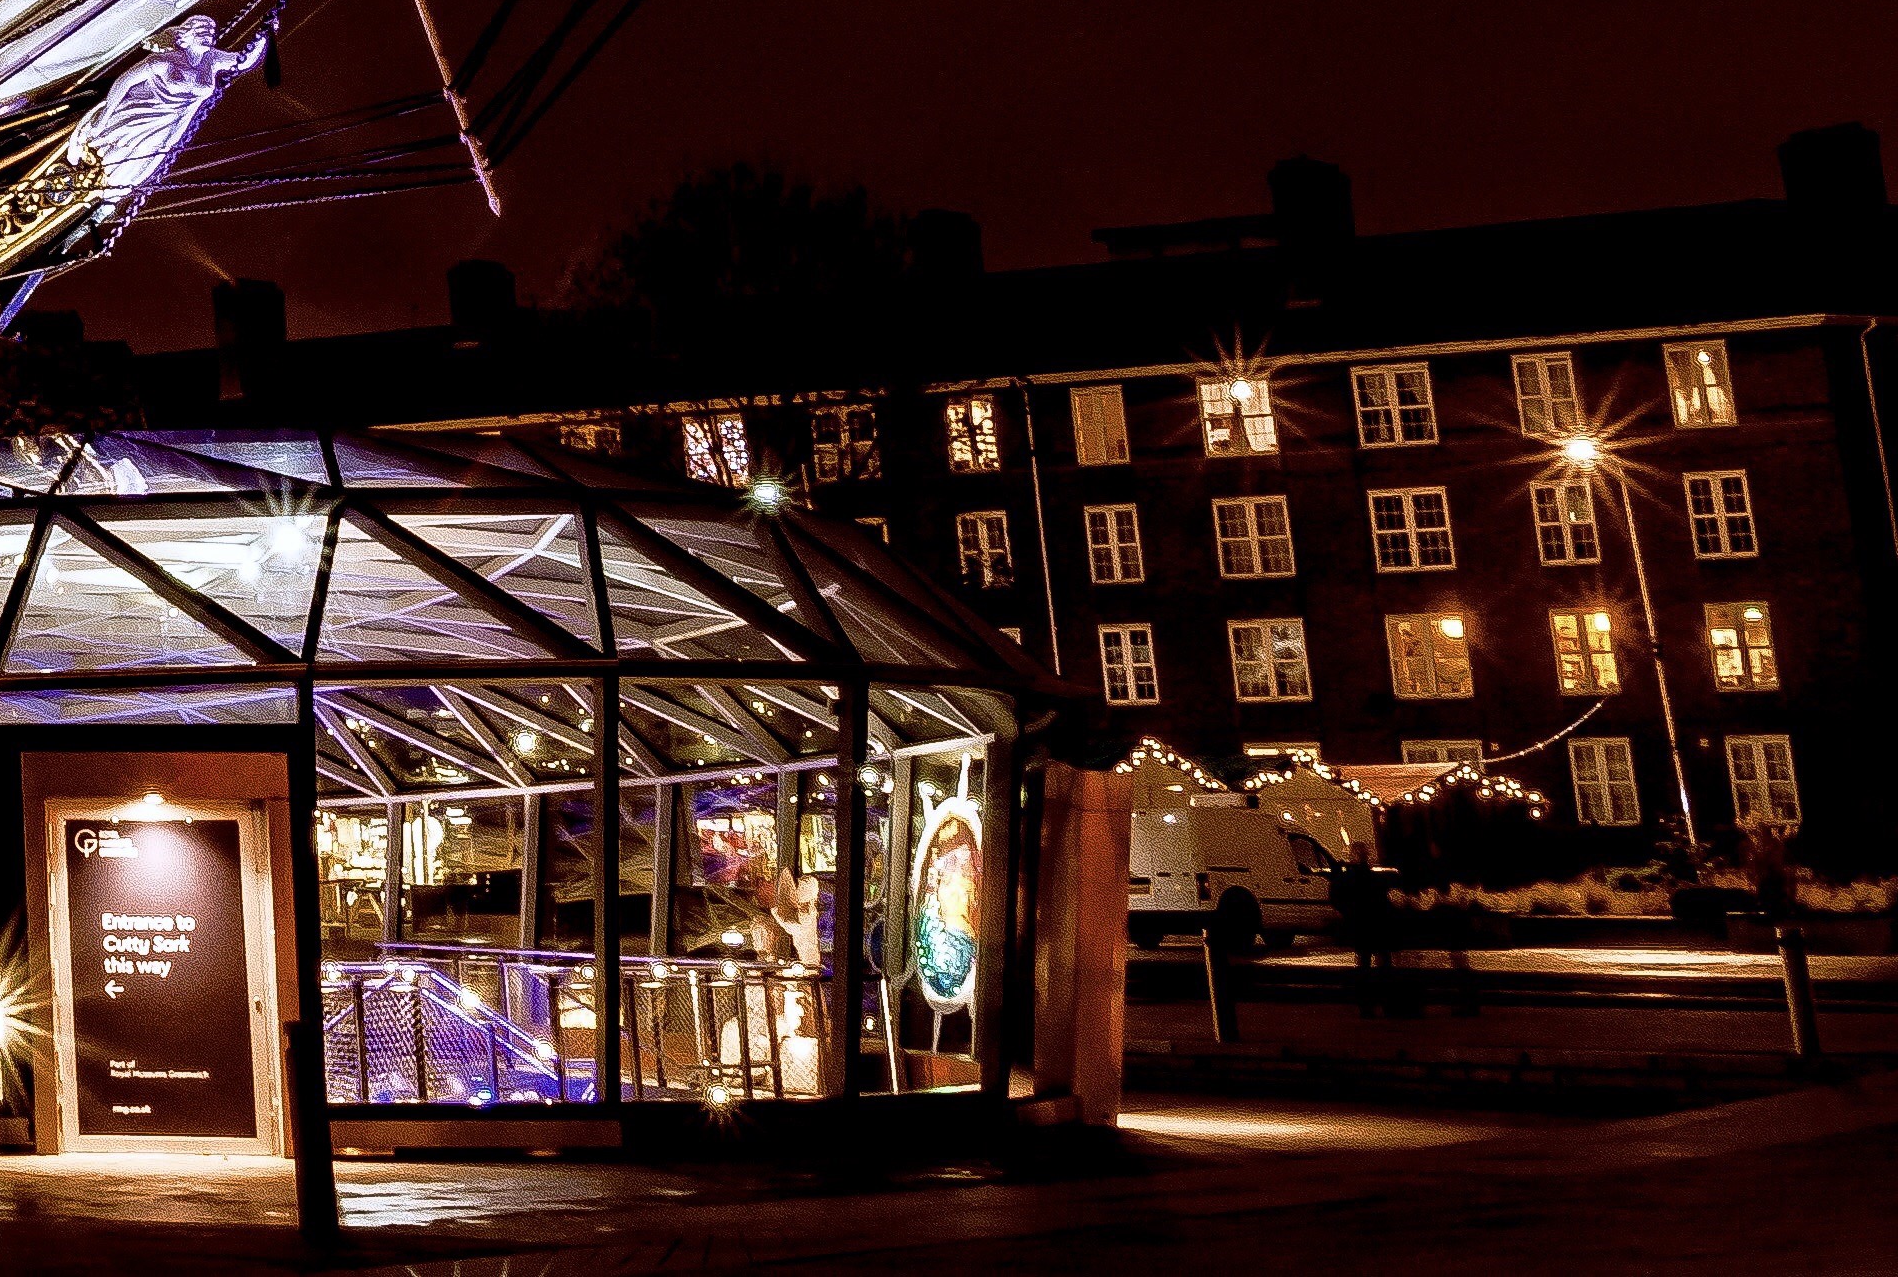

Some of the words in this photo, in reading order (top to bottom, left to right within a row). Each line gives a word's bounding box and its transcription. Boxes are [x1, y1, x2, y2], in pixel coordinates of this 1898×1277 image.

[102, 912, 175, 931] Entrance
[176, 914, 196, 931] to
[103, 934, 150, 955] Cutty
[153, 934, 191, 953] Sark
[104, 956, 134, 974] this
[136, 960, 171, 978] way
